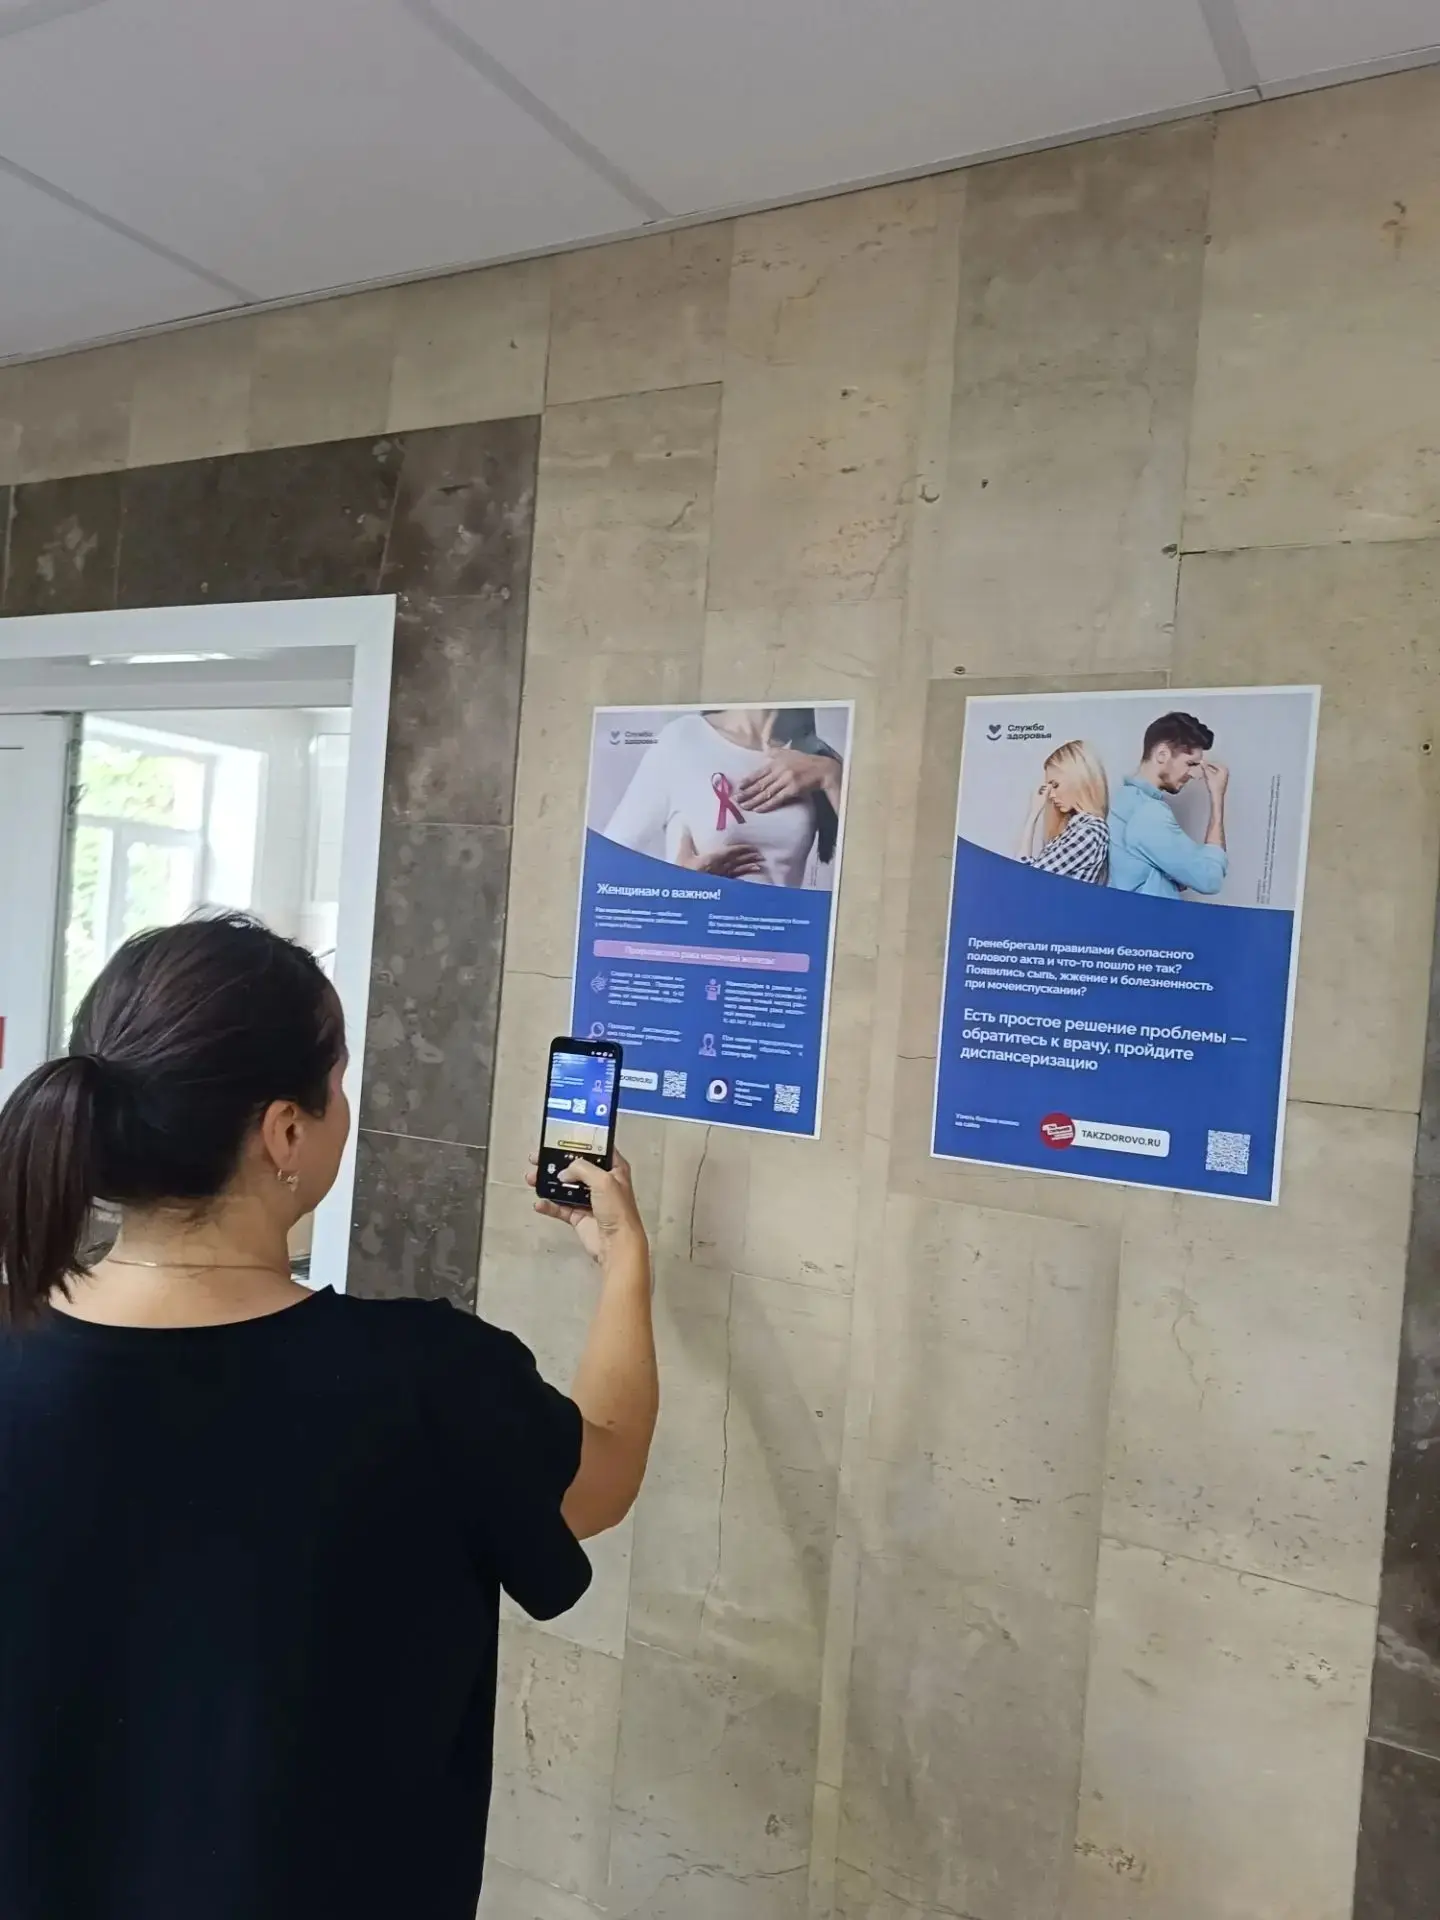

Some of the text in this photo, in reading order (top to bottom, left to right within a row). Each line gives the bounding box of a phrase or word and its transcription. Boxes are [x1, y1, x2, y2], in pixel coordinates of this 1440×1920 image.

[1007, 723, 1045, 733] Служба
[1007, 733, 1052, 741] здоровья
[596, 882, 721, 900] Женщинам о важном!
[967, 937, 1195, 961] Пренебрегали правилами безопасного
[966, 952, 1183, 974] полового акта и что-то пошло не так?
[964, 979, 1088, 997] при мочеиспускании?
[965, 964, 1214, 992] Появились сыпь, жжение и болезненность
[963, 1007, 996, 1024] Есть
[999, 1012, 1062, 1028] простое
[1064, 1018, 1138, 1036] решение
[1139, 1025, 1227, 1044] проблемы
[961, 1026, 1195, 1061] обратитесь к врачу, пройдите
[960, 1046, 1099, 1071] диспансеризацию
[1081, 1129, 1161, 1147] TAKZDOROVO.RU
